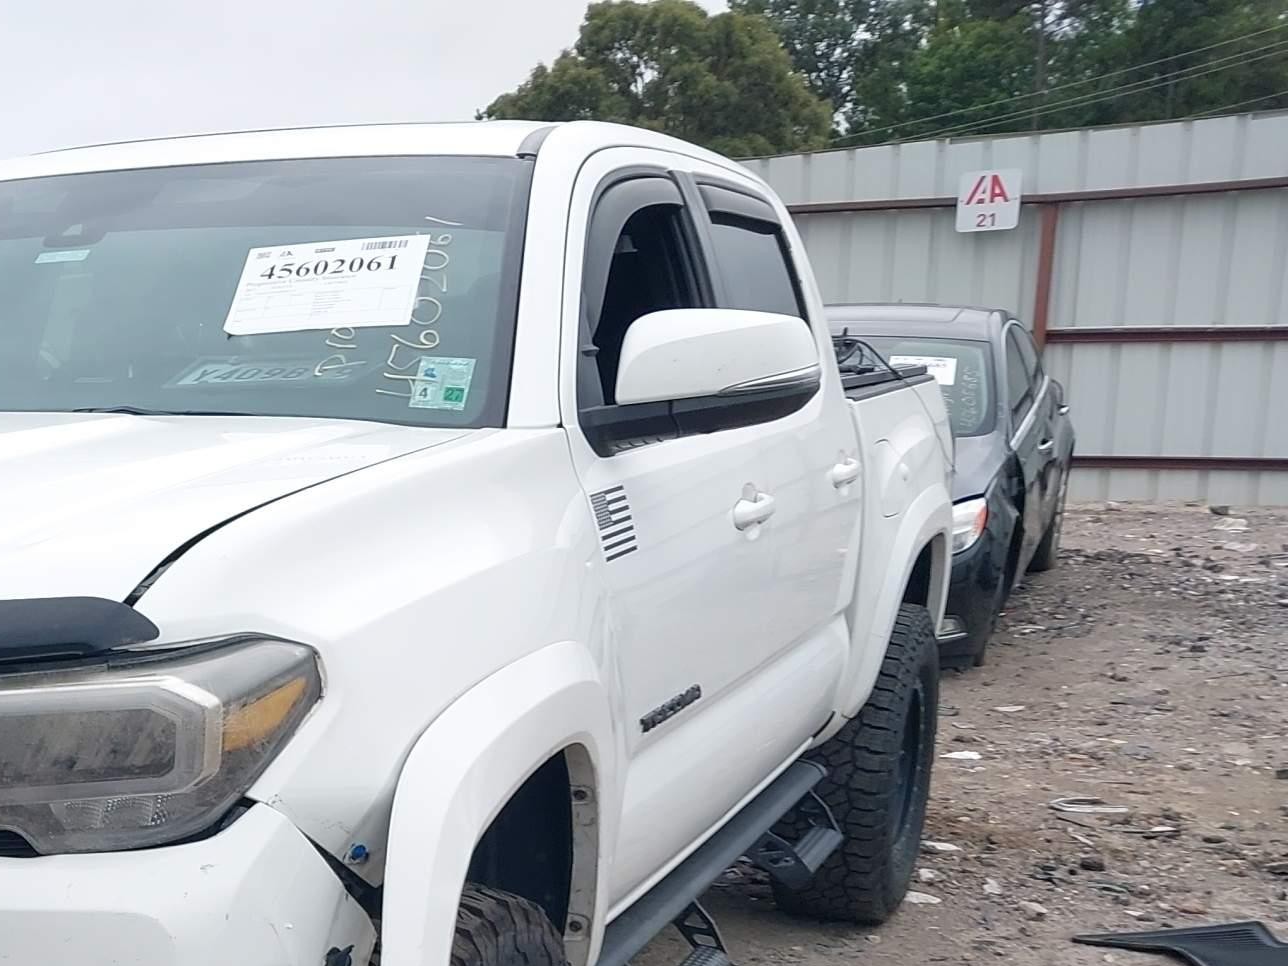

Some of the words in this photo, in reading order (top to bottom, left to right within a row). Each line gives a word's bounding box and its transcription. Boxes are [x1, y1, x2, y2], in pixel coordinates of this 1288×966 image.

[976, 213, 996, 227] 21
[259, 255, 398, 279] 45602061
[419, 387, 428, 399] 4
